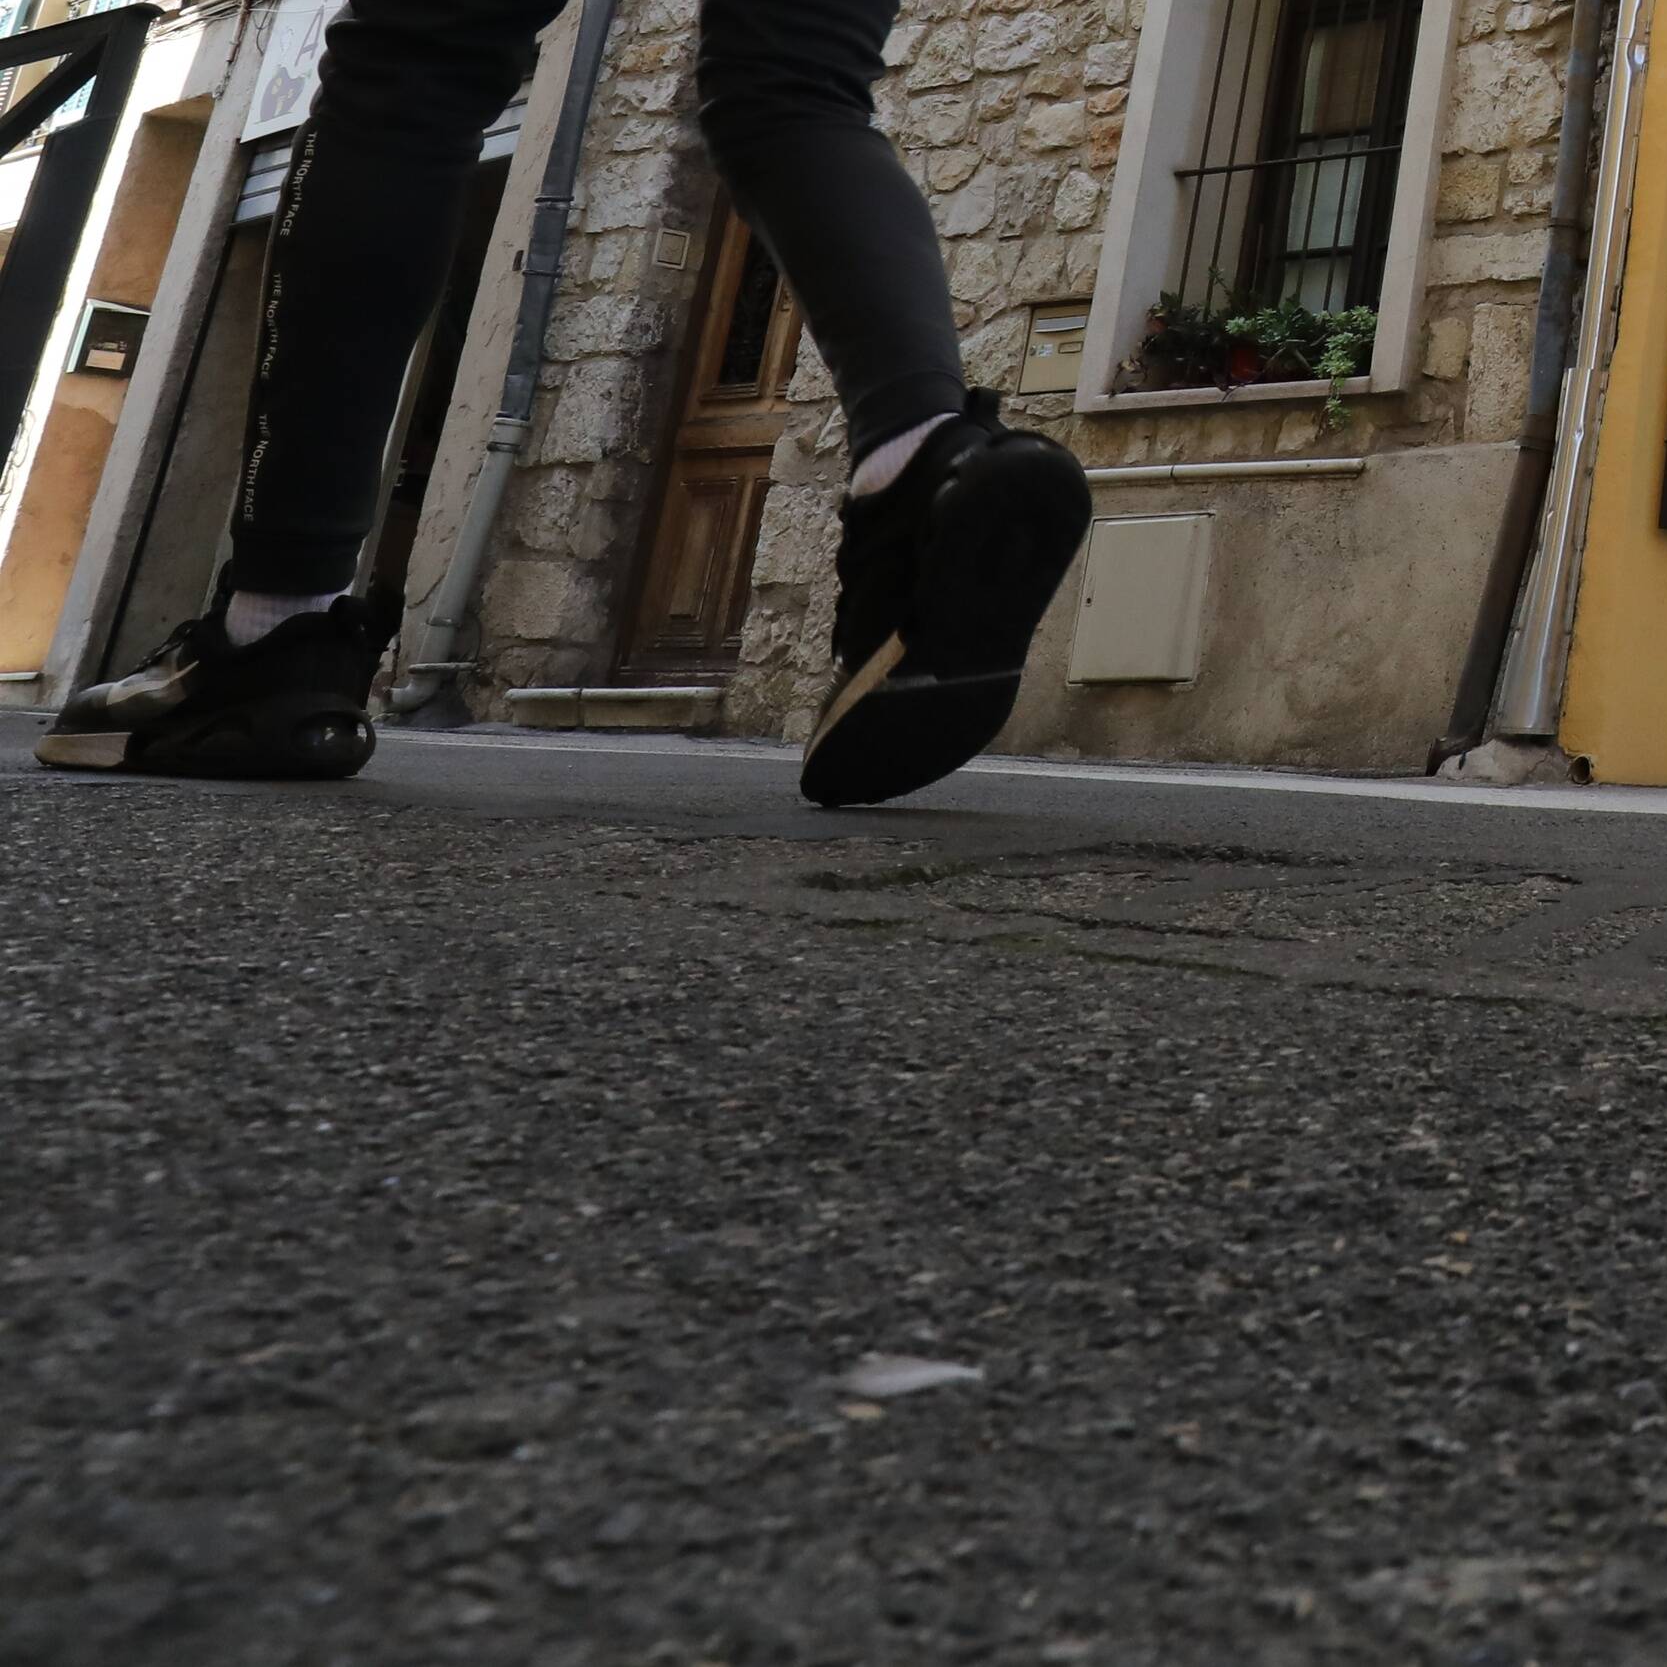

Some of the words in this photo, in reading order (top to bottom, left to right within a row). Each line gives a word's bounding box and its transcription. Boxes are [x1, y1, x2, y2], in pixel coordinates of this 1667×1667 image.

[304, 131, 318, 157] THE
[292, 159, 313, 201] NORTH
[280, 204, 300, 237] FACE
[266, 300, 279, 343] NORTH
[261, 346, 276, 380] FACE
[246, 440, 269, 485] NORTH
[244, 488, 256, 522] FACE
